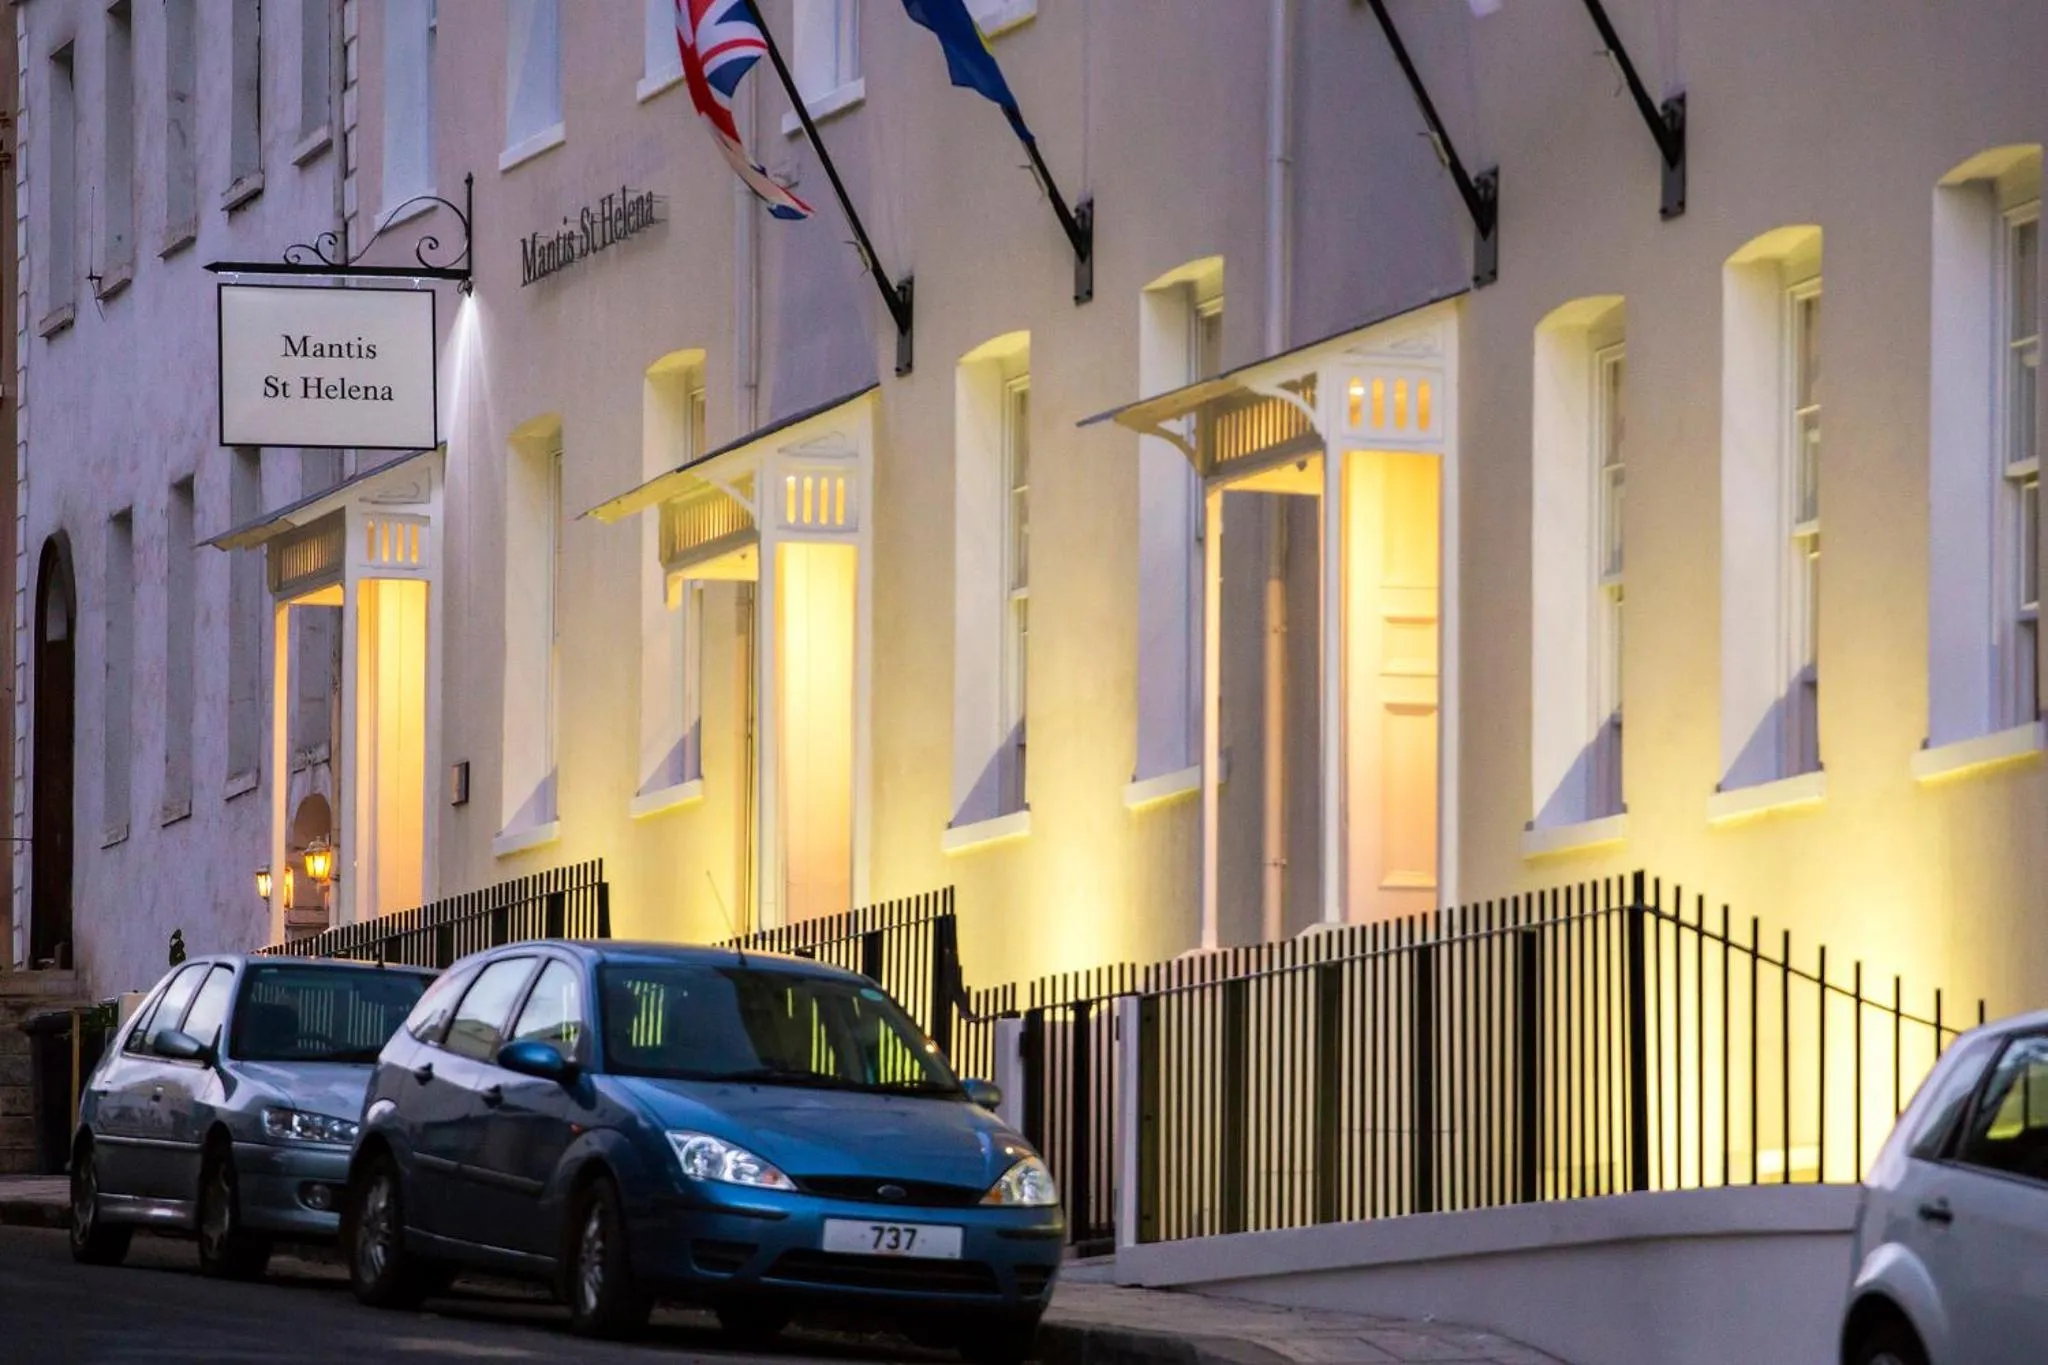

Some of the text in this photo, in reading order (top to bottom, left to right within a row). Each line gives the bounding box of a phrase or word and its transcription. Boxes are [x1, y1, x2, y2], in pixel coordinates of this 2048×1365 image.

[520, 184, 655, 287] Mantis St Helena
[280, 334, 377, 360] Mantis
[263, 375, 394, 401] St Helena
[870, 1225, 918, 1251] 737
